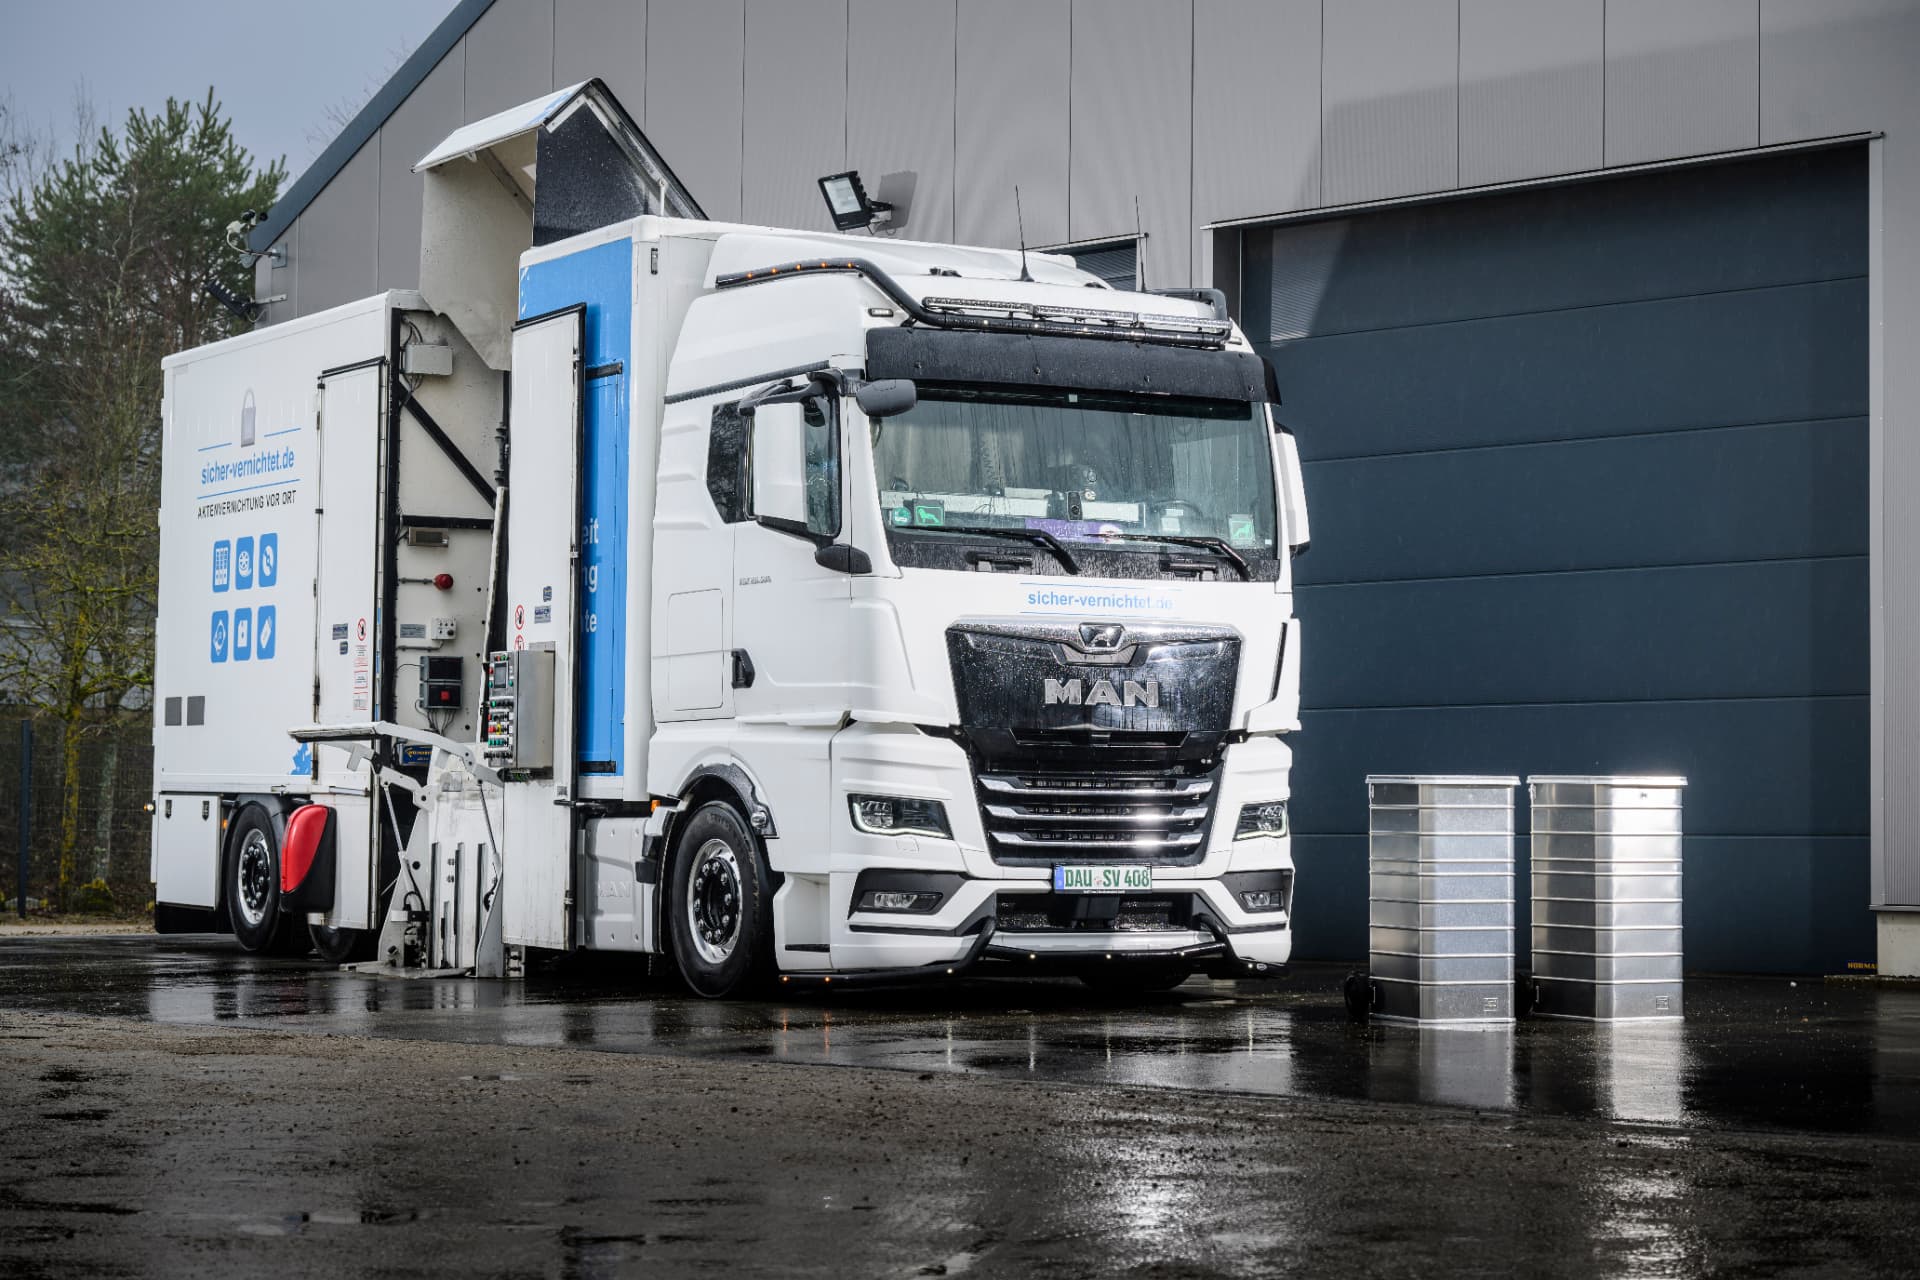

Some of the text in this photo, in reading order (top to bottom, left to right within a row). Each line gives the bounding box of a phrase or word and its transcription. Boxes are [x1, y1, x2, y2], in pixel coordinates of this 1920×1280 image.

[201, 446, 294, 485] sicher-vernichtet.de
[197, 489, 297, 520] AKTENVERNICHTUNG VOR ORT
[1028, 591, 1173, 609] sicher-vernichtet.de
[581, 608, 597, 632] te
[1044, 678, 1159, 708] MAN
[1065, 869, 1150, 887] DAU SV 408
